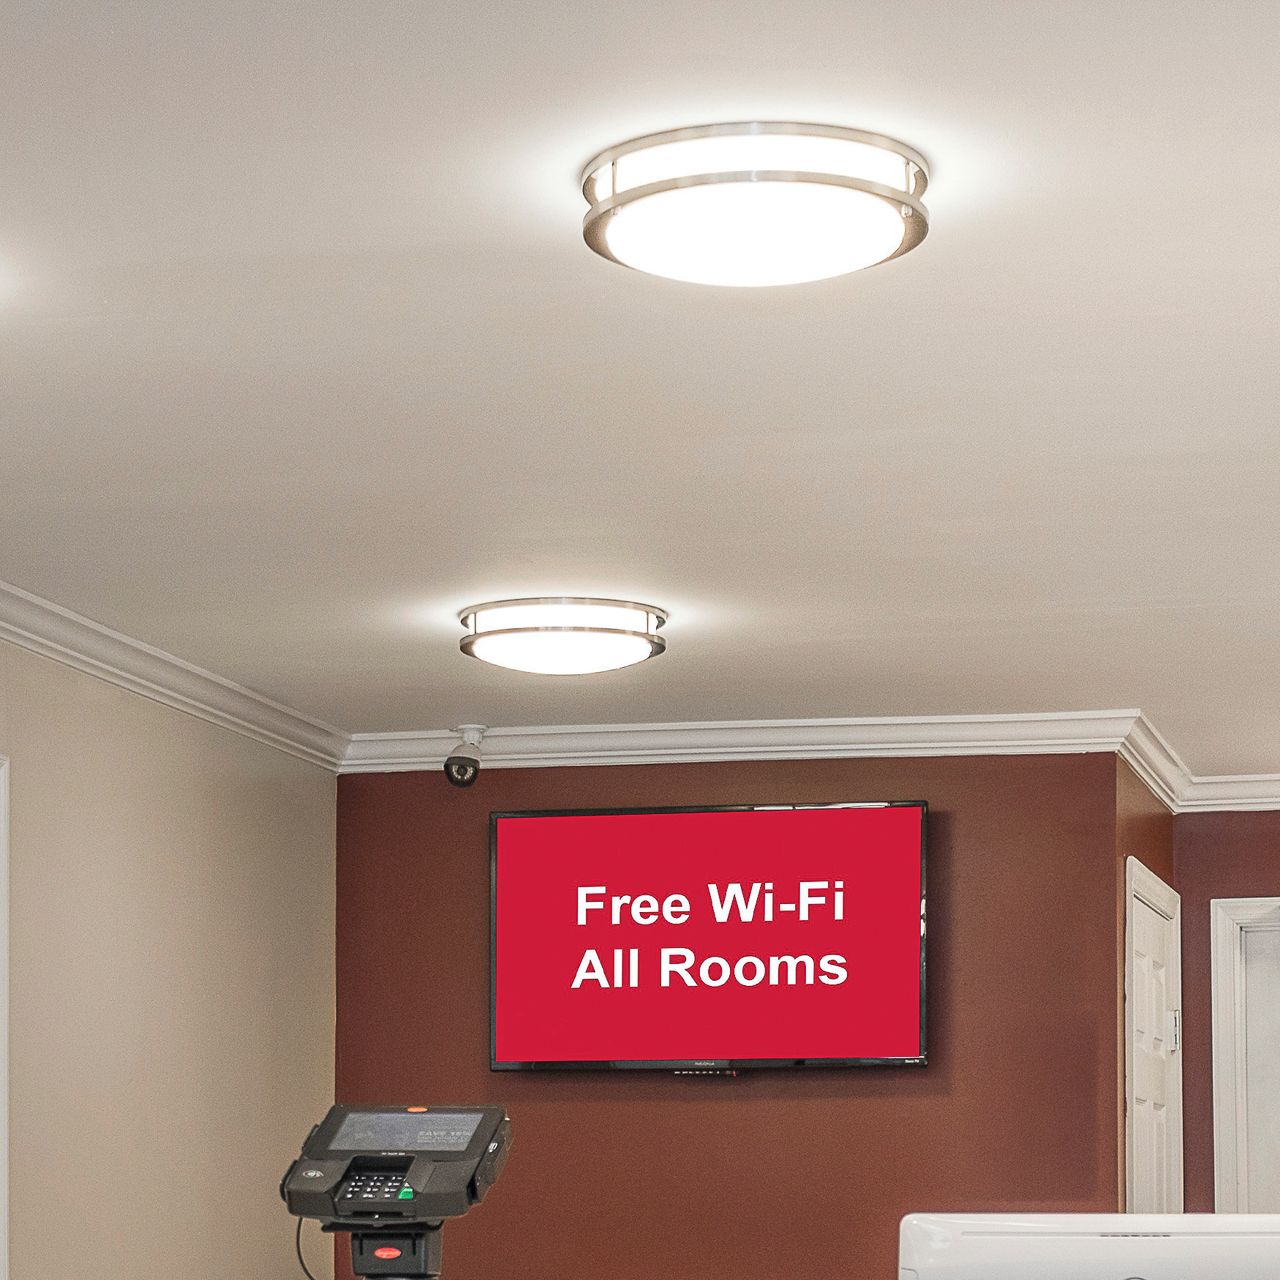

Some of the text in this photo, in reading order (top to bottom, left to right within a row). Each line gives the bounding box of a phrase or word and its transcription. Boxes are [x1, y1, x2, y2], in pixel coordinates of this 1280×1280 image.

[576, 880, 845, 926] Free Wi-Fi
[570, 947, 848, 989] All Rooms
